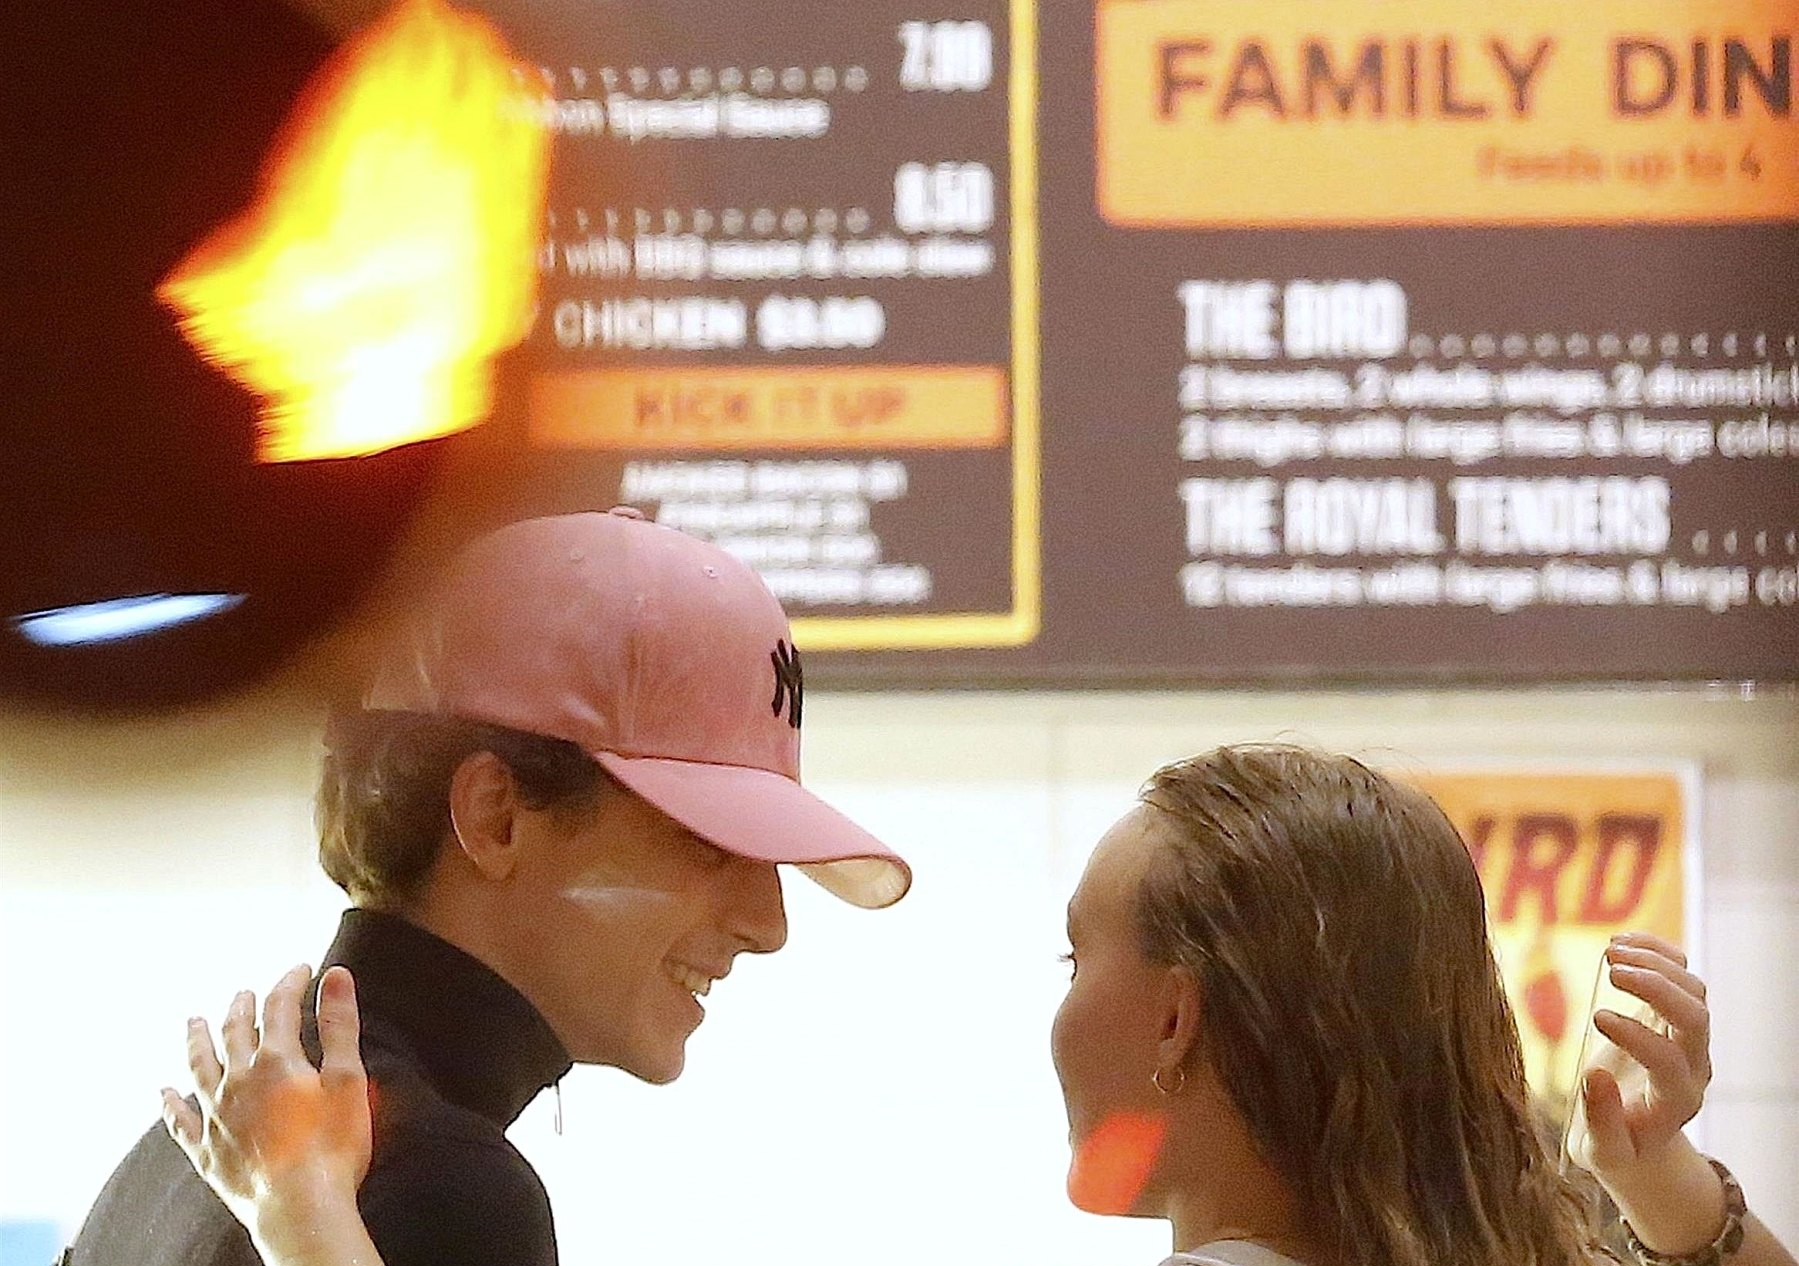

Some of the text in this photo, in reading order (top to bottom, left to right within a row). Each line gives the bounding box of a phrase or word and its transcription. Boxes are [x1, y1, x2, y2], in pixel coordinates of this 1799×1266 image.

[1156, 34, 1792, 120] FAMILY DIN
[1476, 141, 1603, 182] Feeds
[1618, 148, 1673, 188] up
[1684, 144, 1726, 182] to
[553, 297, 748, 350] CHICKEN
[1176, 278, 1408, 359] THE BIRD
[1352, 362, 1388, 408] 2
[1389, 362, 1498, 409] whole
[1611, 361, 1645, 408] 2
[1327, 412, 1403, 460] with
[1588, 411, 1622, 458] &
[1176, 475, 1672, 556] THE ROYAL TENDERS
[1364, 559, 1443, 607] with
[1626, 558, 1660, 606] &
[1755, 563, 1799, 607] co
